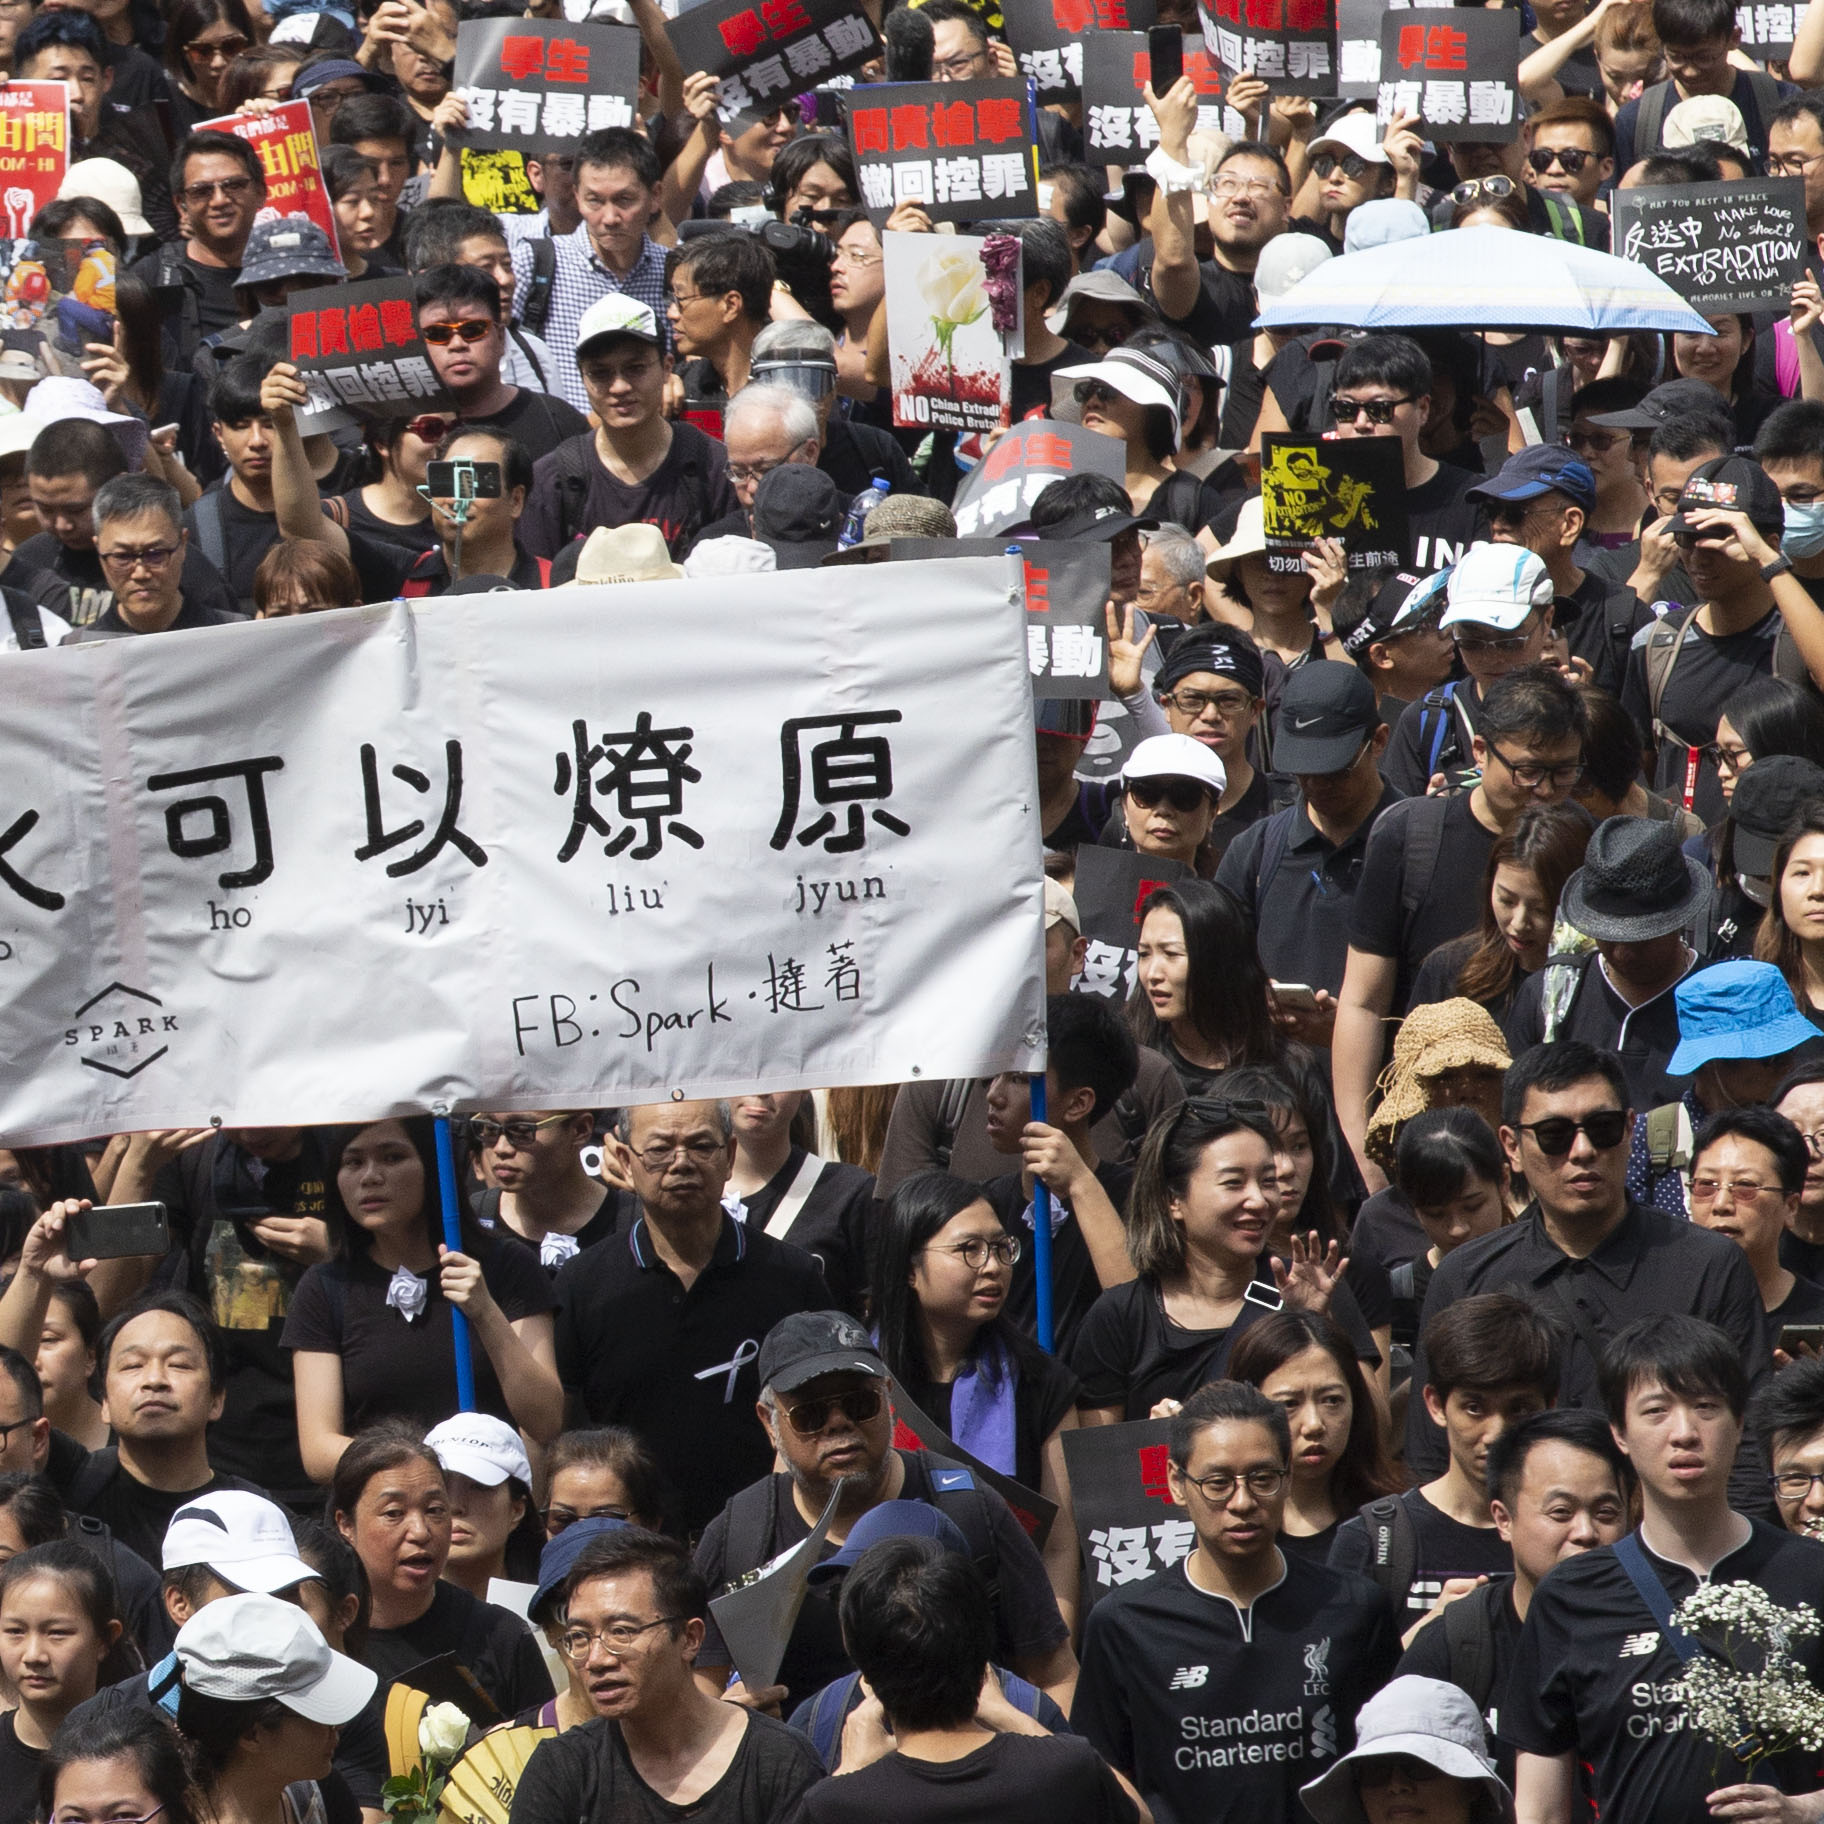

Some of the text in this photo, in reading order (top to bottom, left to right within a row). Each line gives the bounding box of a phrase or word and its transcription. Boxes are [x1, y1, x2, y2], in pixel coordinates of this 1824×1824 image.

[502, 37, 591, 84] 學生
[1399, 26, 1469, 71] 學生
[717, 18, 870, 120] 沒有暴動
[459, 82, 633, 137] 沒有暴動
[853, 99, 1024, 155] 問責槍擊
[1672, 199, 1690, 209] YOU
[1739, 193, 1768, 204] PEACE
[1714, 206, 1758, 223] MAKE
[1626, 215, 1704, 257] 反送中
[1656, 240, 1801, 275] EXTRADITION
[1692, 267, 1779, 286] TO CHINA
[290, 299, 418, 361] 問責槍擊
[900, 394, 930, 424] NO
[931, 398, 960, 412] China
[932, 412, 964, 429] Police
[1282, 490, 1308, 506] NO
[207, 900, 252, 931] ho
[405, 896, 450, 936] jyi
[607, 883, 664, 916] liu
[795, 874, 888, 916] jyun
[64, 1014, 180, 1046] SPARK
[1376, 1525, 1389, 1565] NIKKO
[1303, 1682, 1331, 1697] LFC
[1180, 1706, 1304, 1740] Standard
[1175, 1729, 1305, 1772] Chartered
